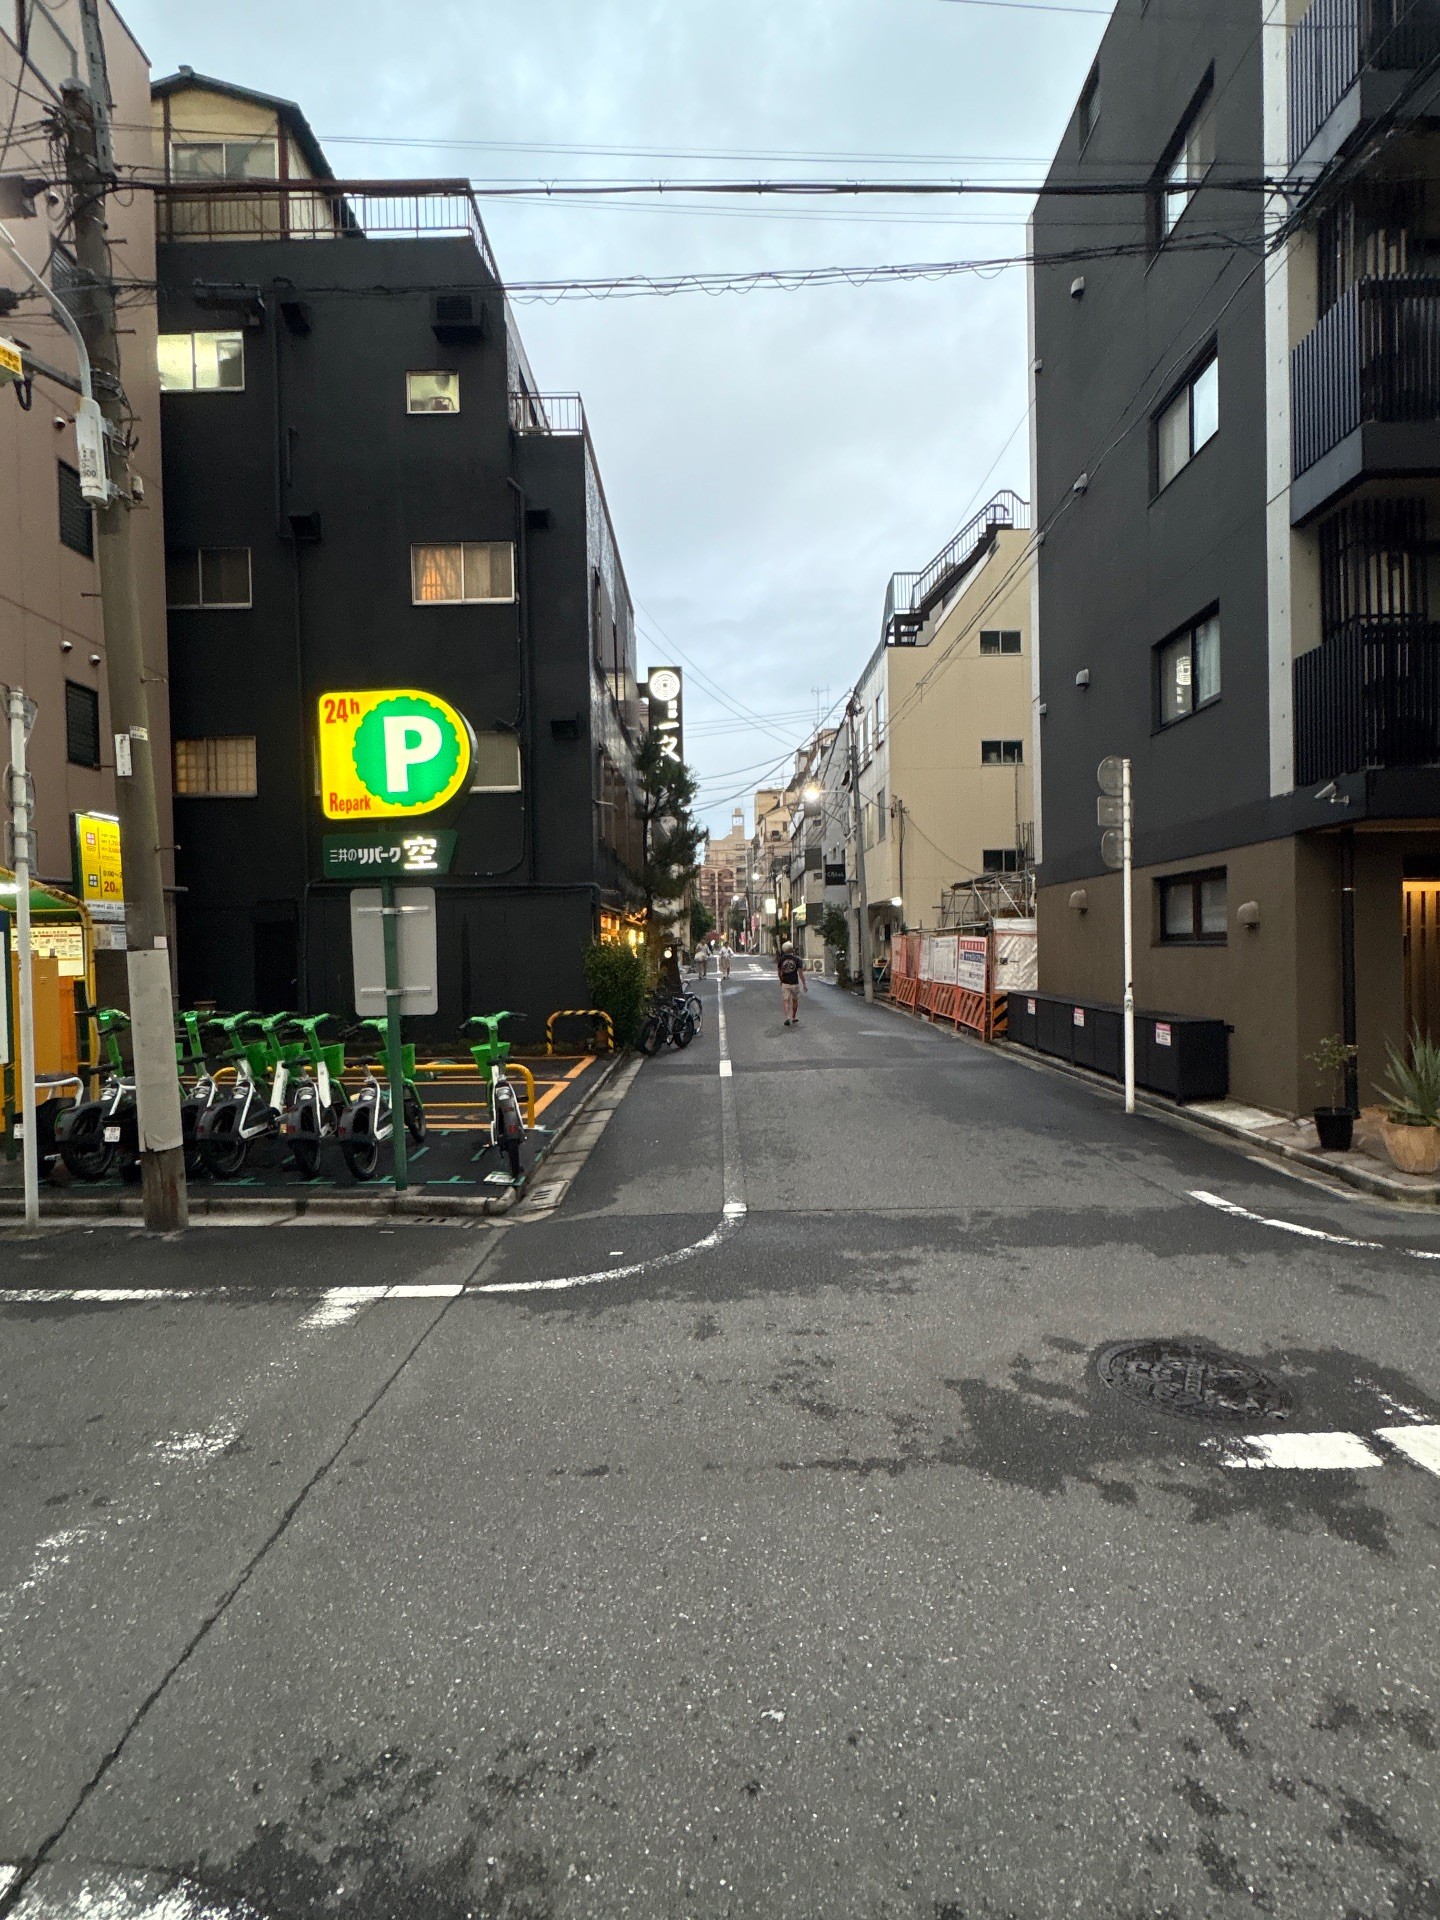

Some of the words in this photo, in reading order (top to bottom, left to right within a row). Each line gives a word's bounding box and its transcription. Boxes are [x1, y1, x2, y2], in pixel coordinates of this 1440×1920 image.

[324, 698, 360, 724] 24h
[383, 715, 443, 793] P
[329, 792, 372, 815] Repark
[329, 844, 401, 865] 三井のリパーク
[402, 835, 438, 870] 空
